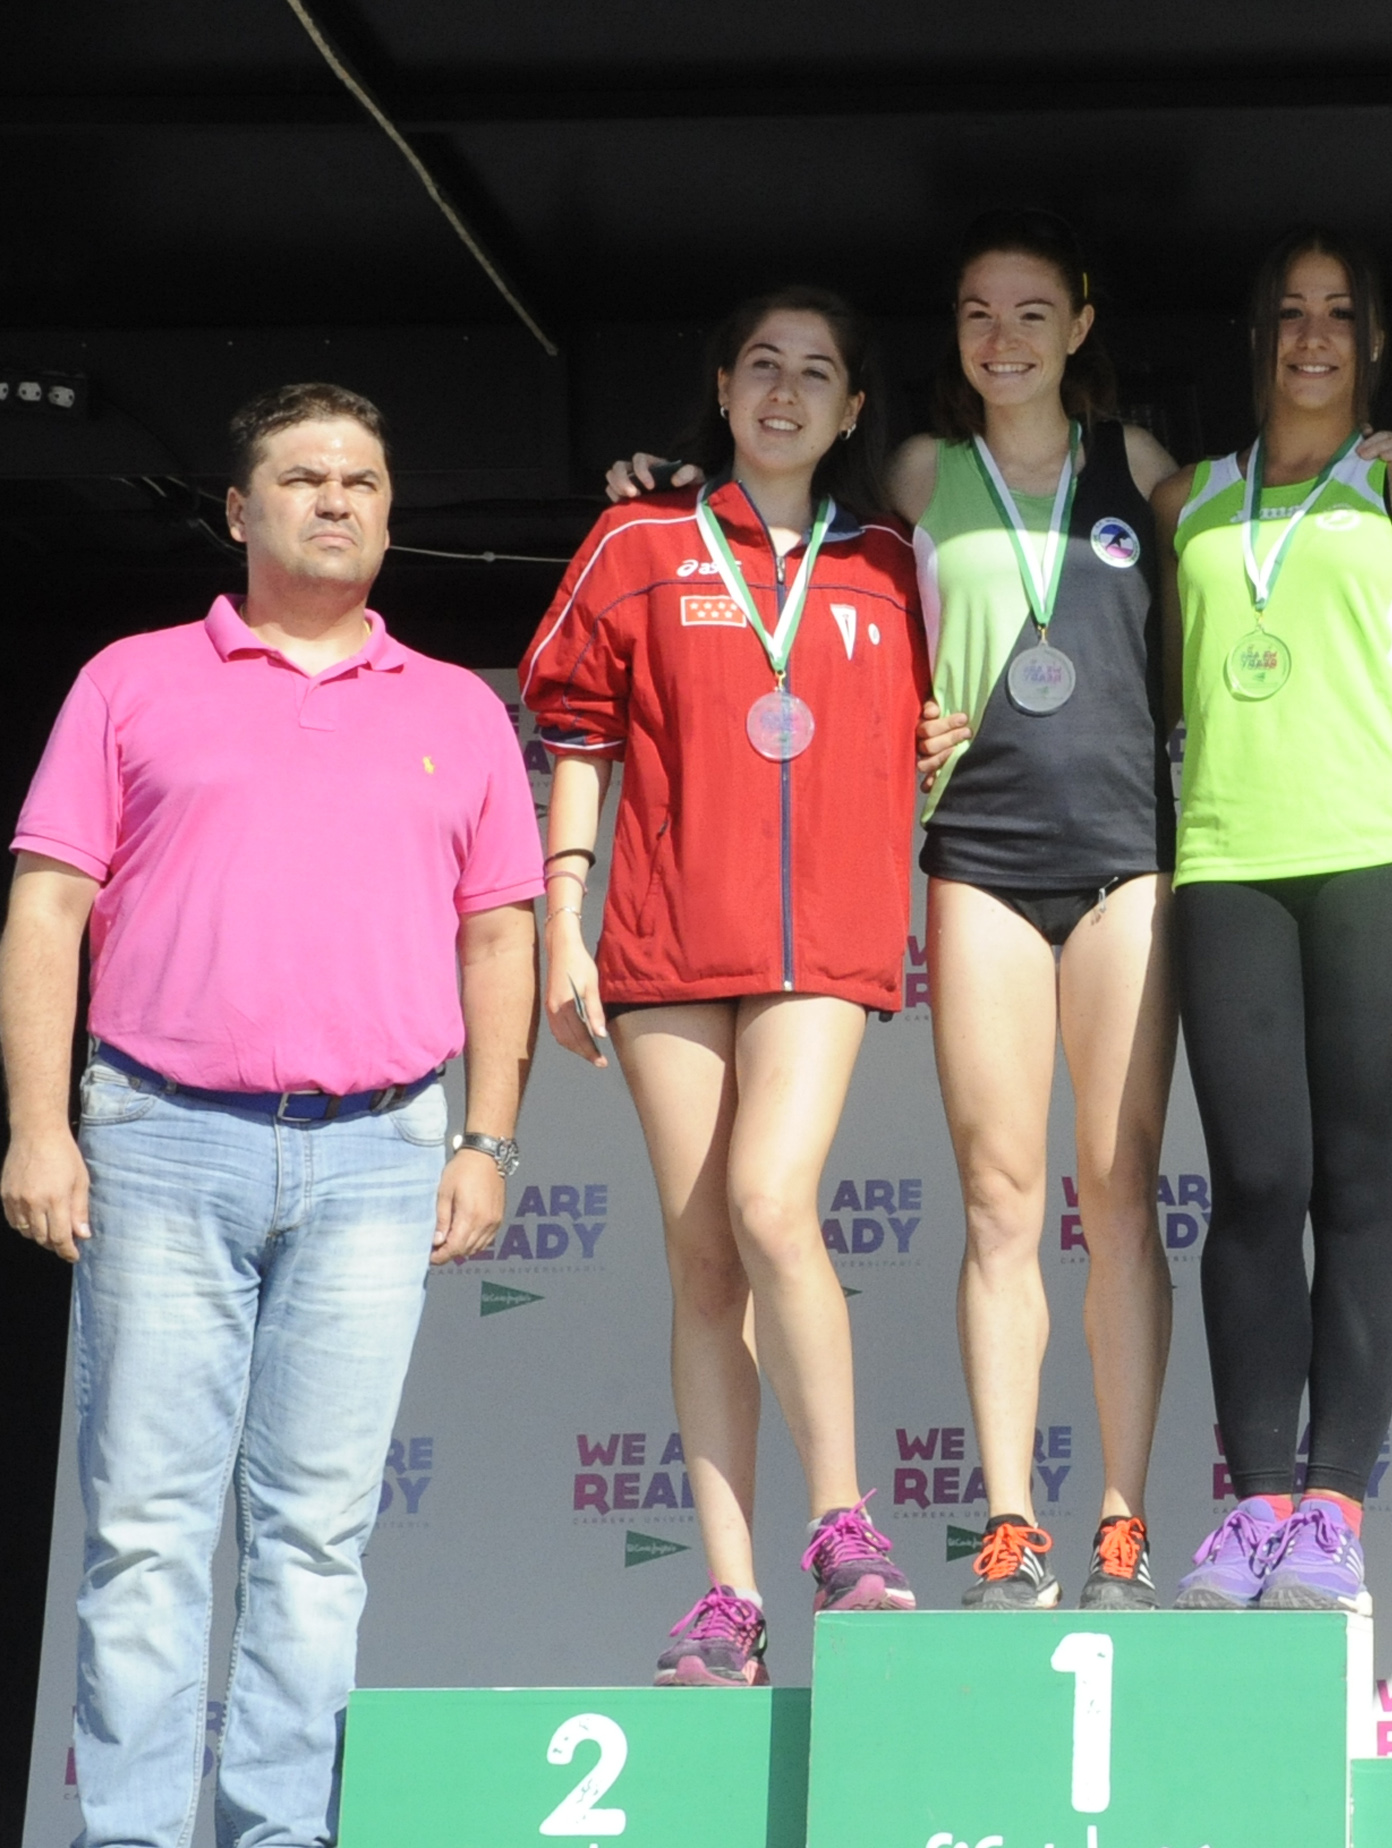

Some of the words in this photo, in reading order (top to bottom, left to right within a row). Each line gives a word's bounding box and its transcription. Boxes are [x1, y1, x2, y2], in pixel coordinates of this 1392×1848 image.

[515, 1184, 608, 1221] ARE
[830, 1178, 923, 1216] ARE
[1157, 1174, 1212, 1211] AR
[820, 1216, 921, 1254] ADY
[386, 1437, 434, 1475] RE
[576, 1433, 647, 1467] WE
[896, 1428, 965, 1461] WE
[573, 1471, 695, 1516] REA
[893, 1465, 1072, 1510] REAY
[1050, 1632, 1113, 1813] 1
[538, 1712, 629, 1837] 2
